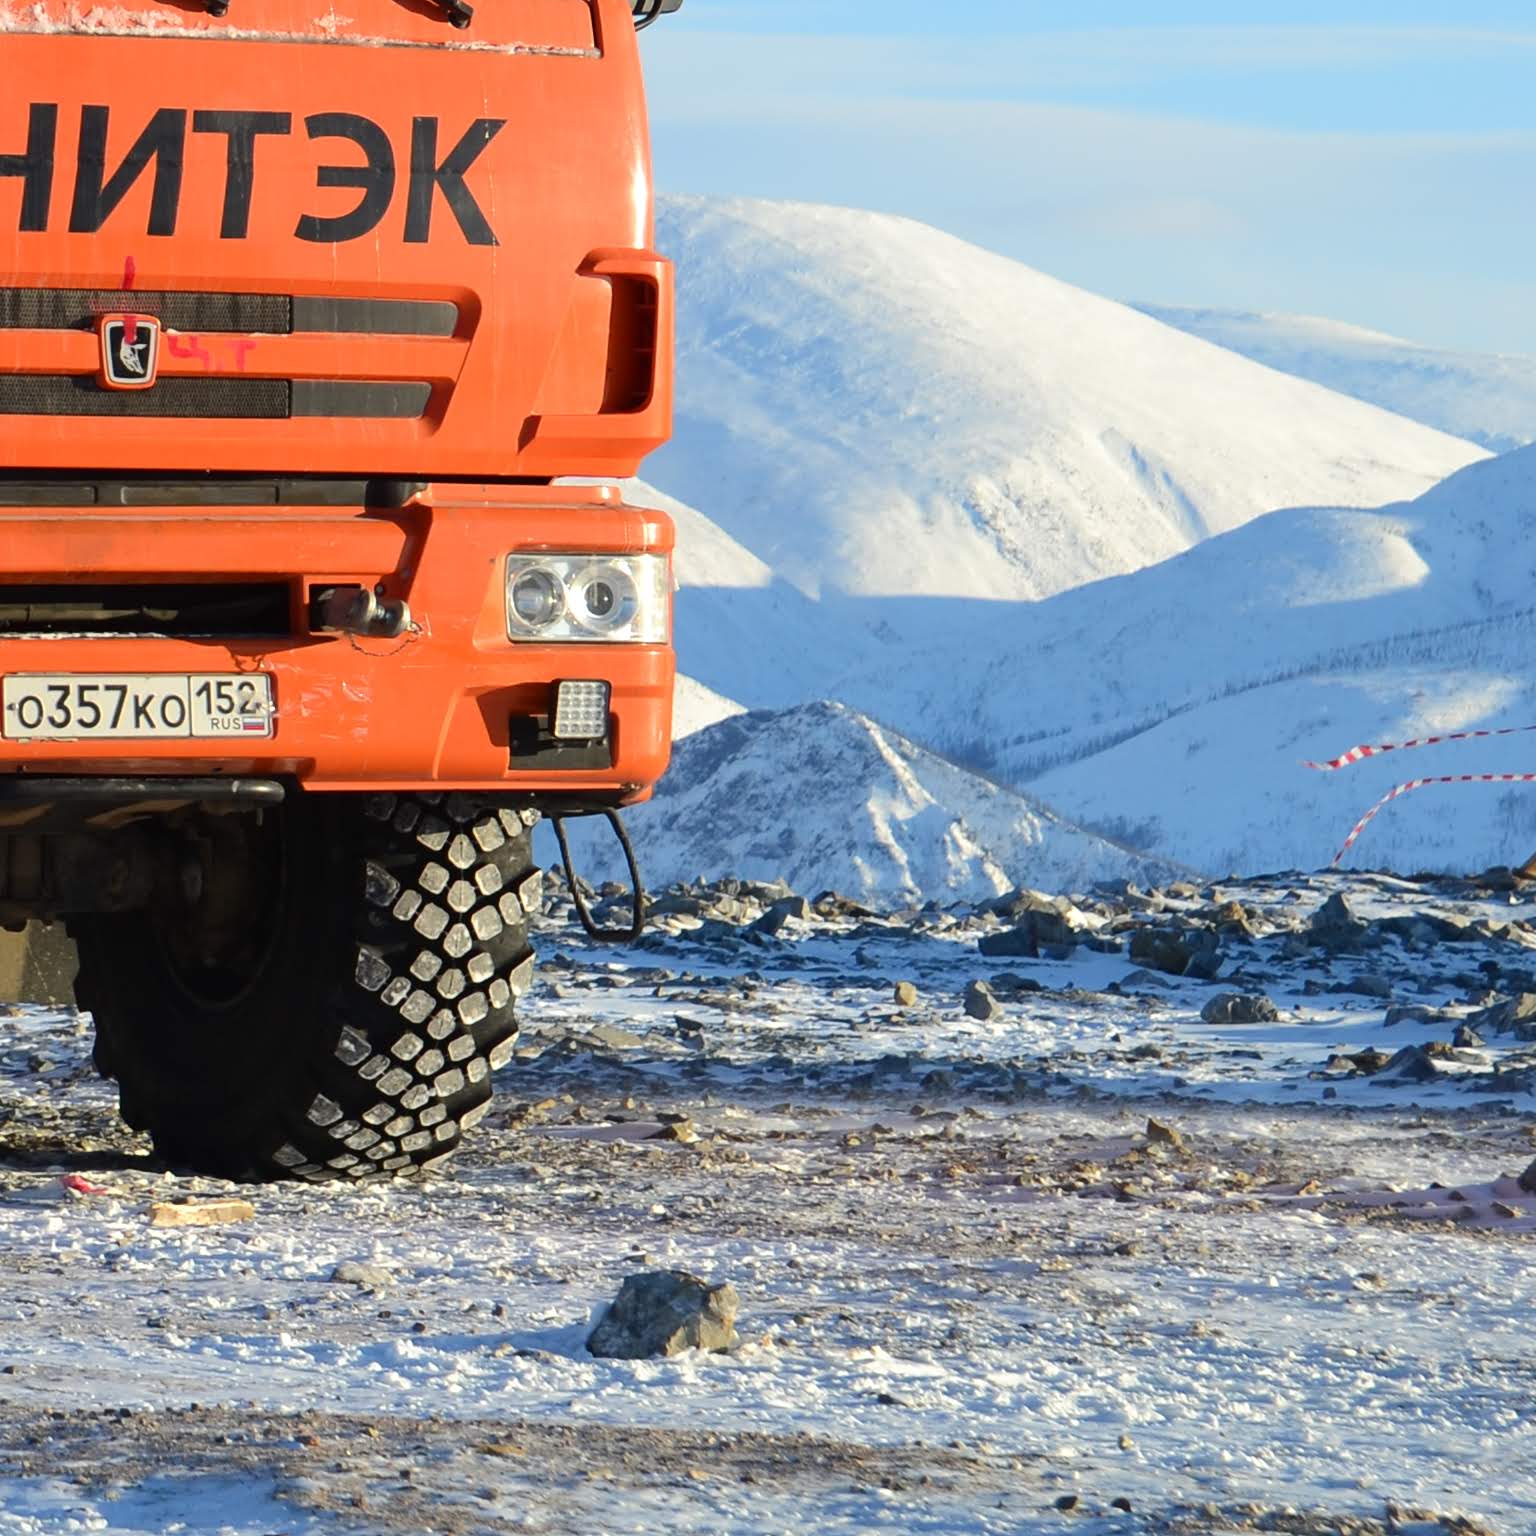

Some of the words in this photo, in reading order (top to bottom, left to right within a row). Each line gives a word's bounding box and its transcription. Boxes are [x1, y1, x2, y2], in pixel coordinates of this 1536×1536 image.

[18, 683, 186, 730] О357КО
[195, 680, 258, 716] 152
[210, 717, 242, 731] RUS
